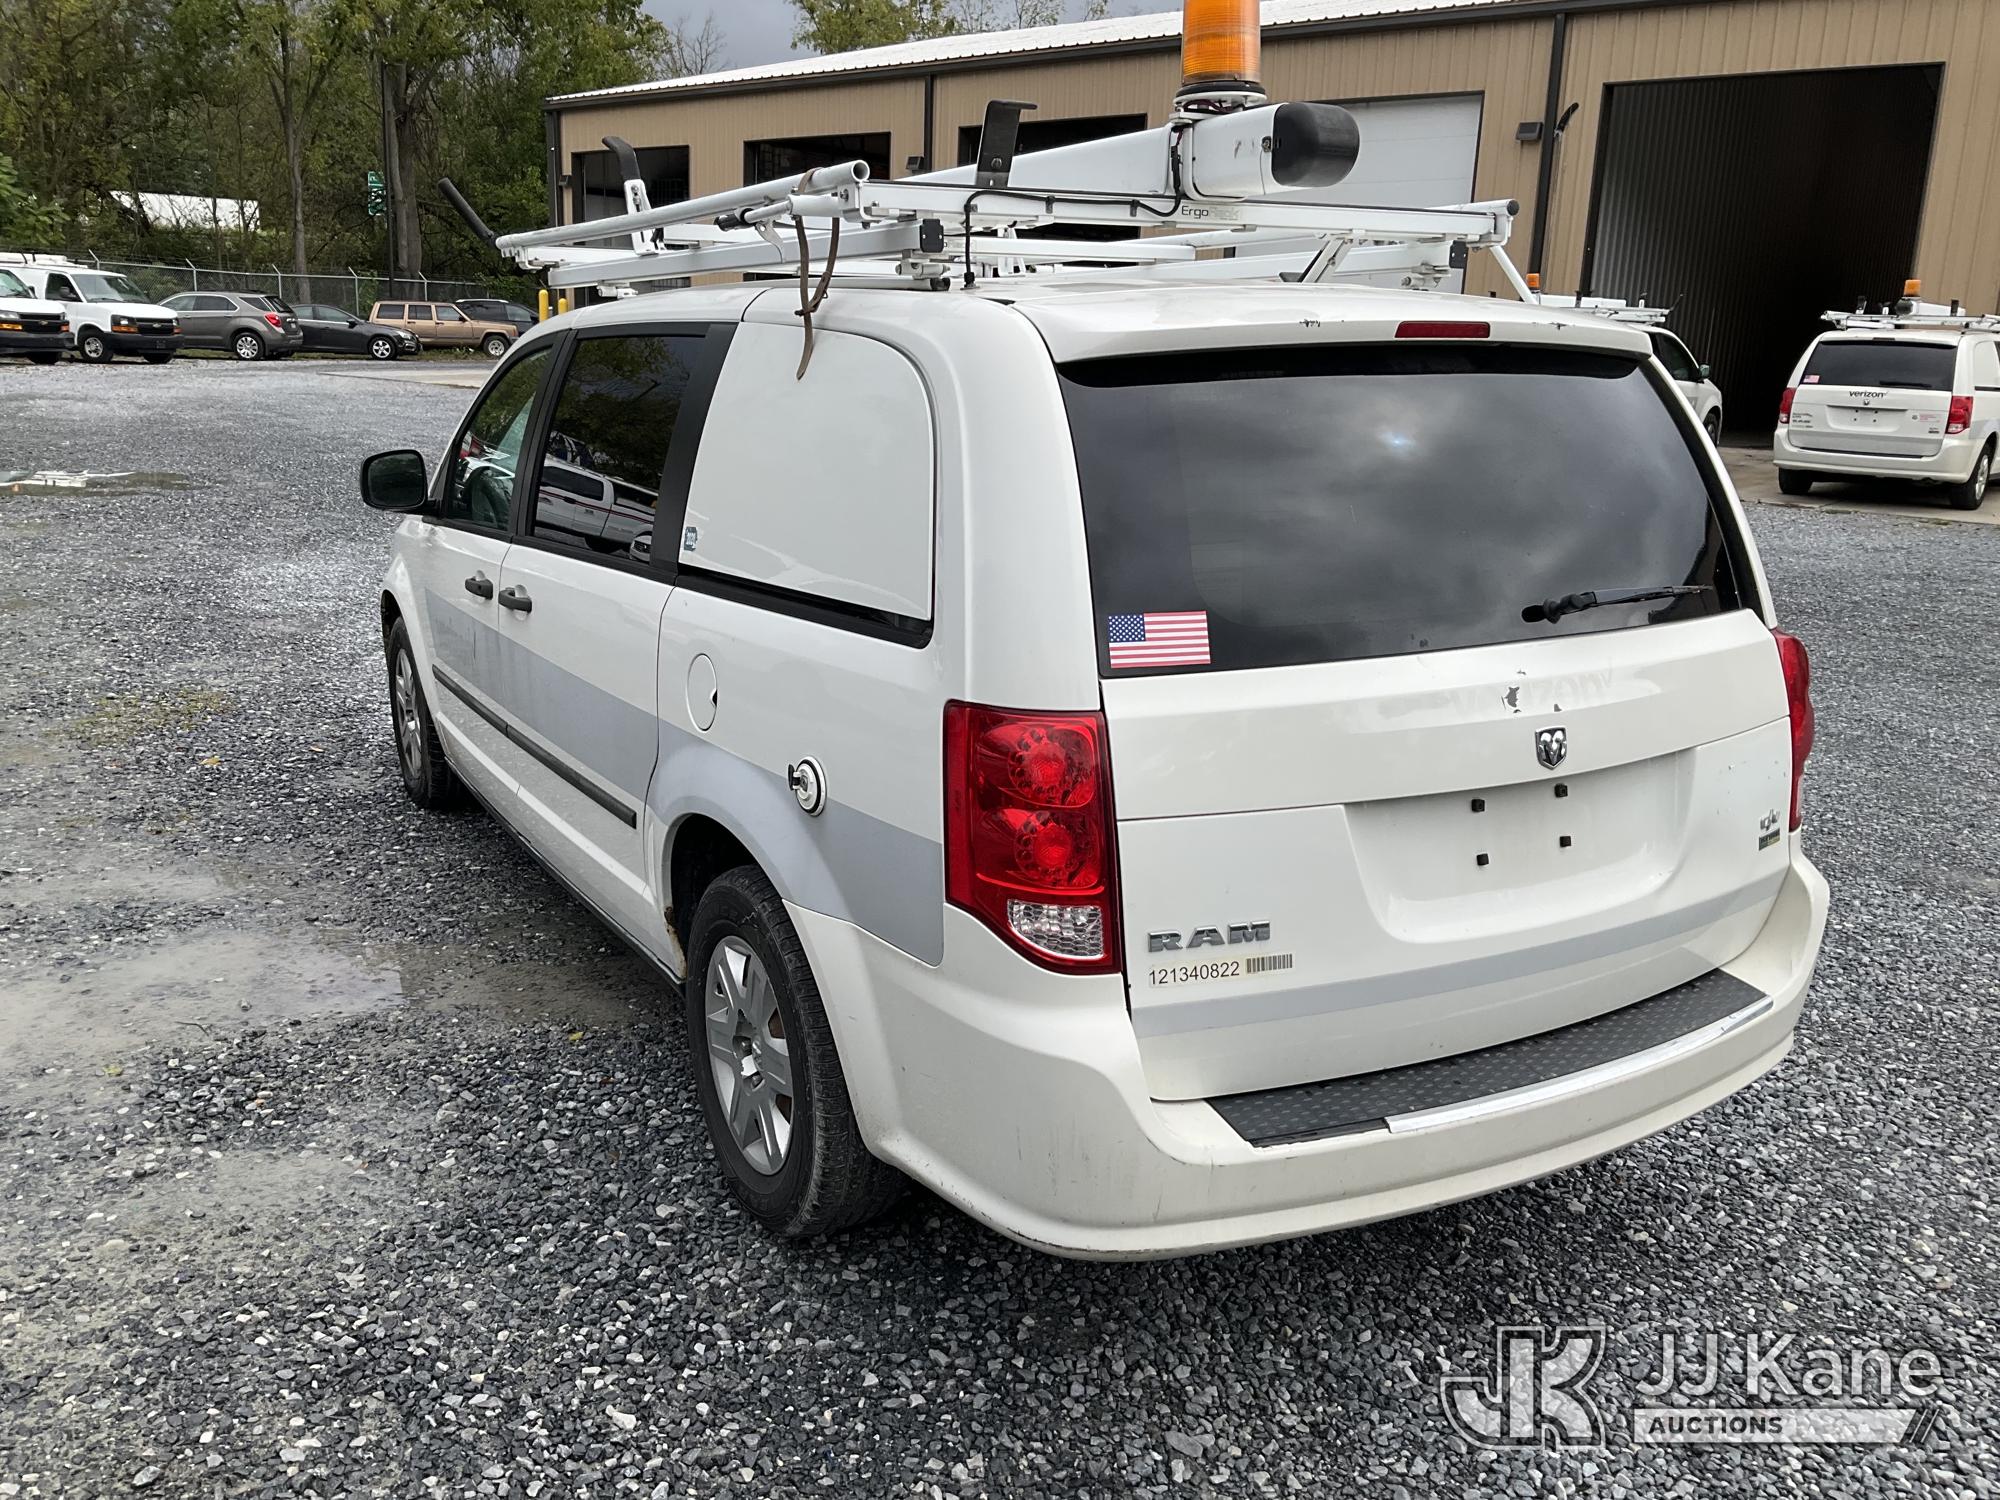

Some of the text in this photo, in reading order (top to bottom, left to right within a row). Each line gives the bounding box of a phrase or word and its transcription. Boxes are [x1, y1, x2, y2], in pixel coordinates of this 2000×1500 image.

[1849, 390, 1885, 398] verizon
[1147, 919, 1271, 953] RAM
[1149, 960, 1240, 985] 121340822
